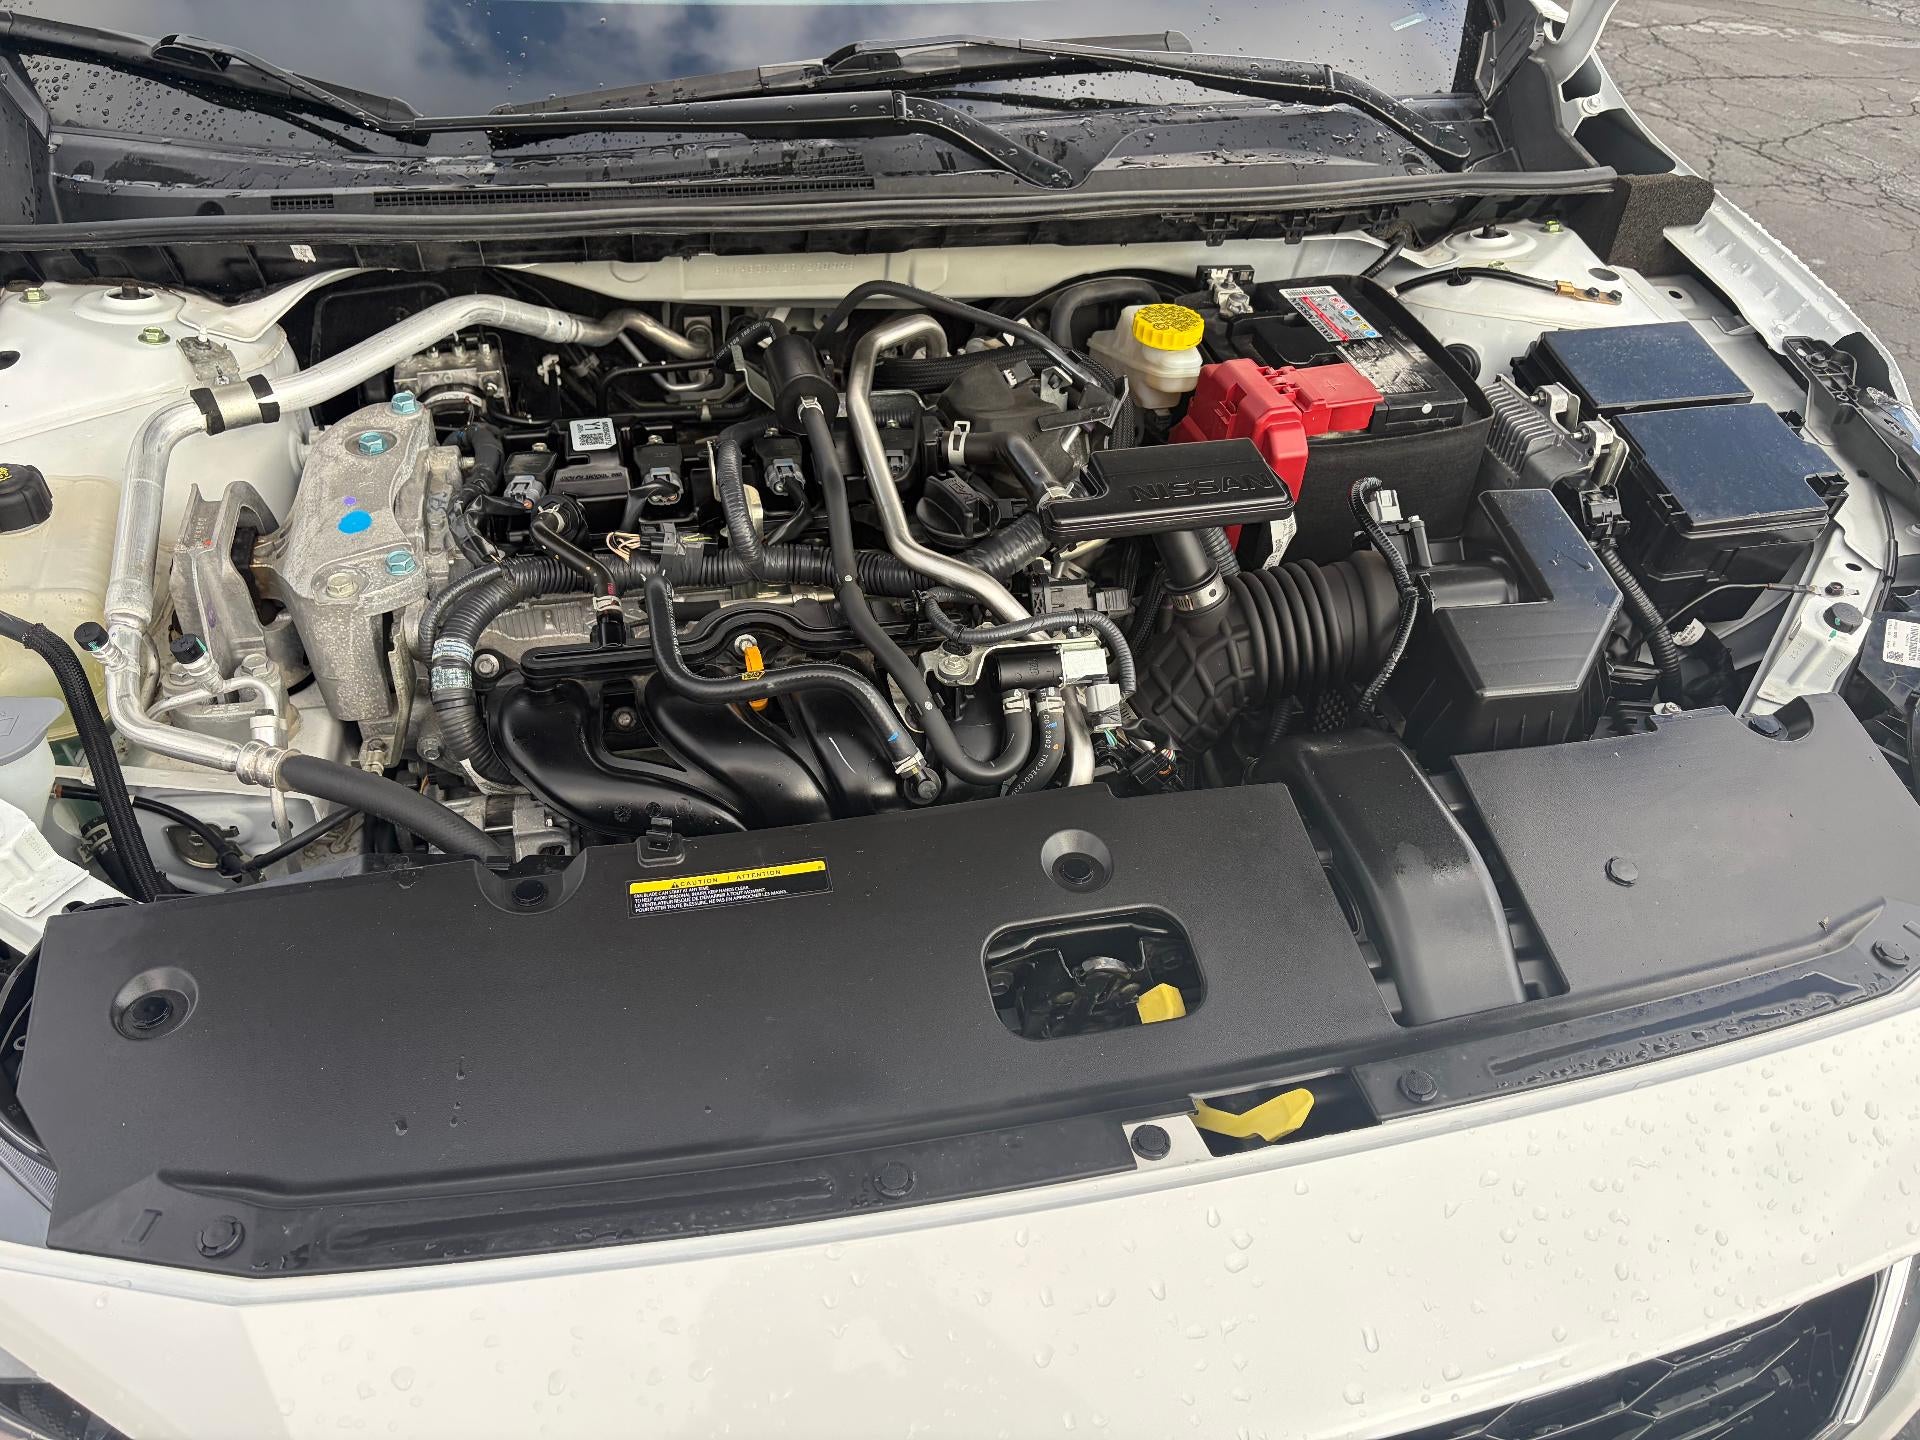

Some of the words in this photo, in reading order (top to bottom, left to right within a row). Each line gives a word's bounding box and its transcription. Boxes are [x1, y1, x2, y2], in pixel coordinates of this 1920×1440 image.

[1128, 474, 1274, 502] NISSAN
[680, 877, 718, 887] CAUTION
[736, 869, 781, 880] ATTENTION
